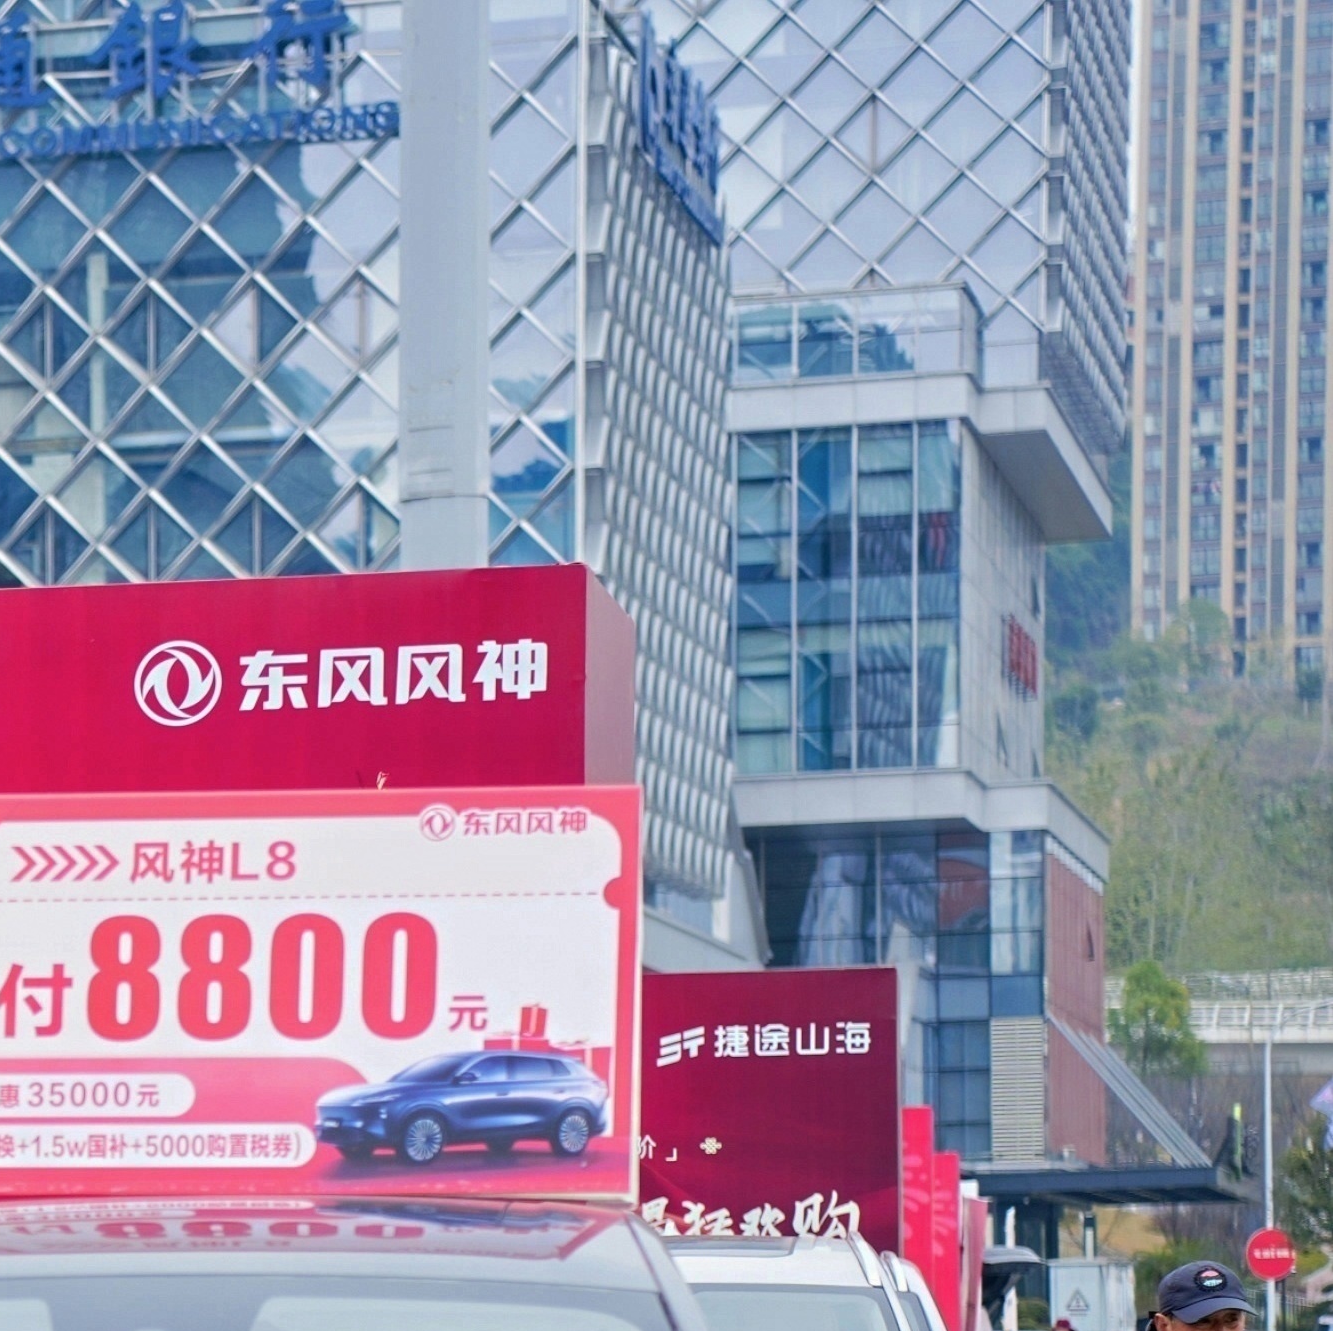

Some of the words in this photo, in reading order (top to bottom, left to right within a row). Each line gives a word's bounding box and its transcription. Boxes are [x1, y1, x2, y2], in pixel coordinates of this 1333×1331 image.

[238, 638, 548, 711] 东风风神
[462, 810, 587, 836] 东风风神
[129, 839, 296, 884] 风神L8
[714, 1021, 872, 1058] 捷途山海
